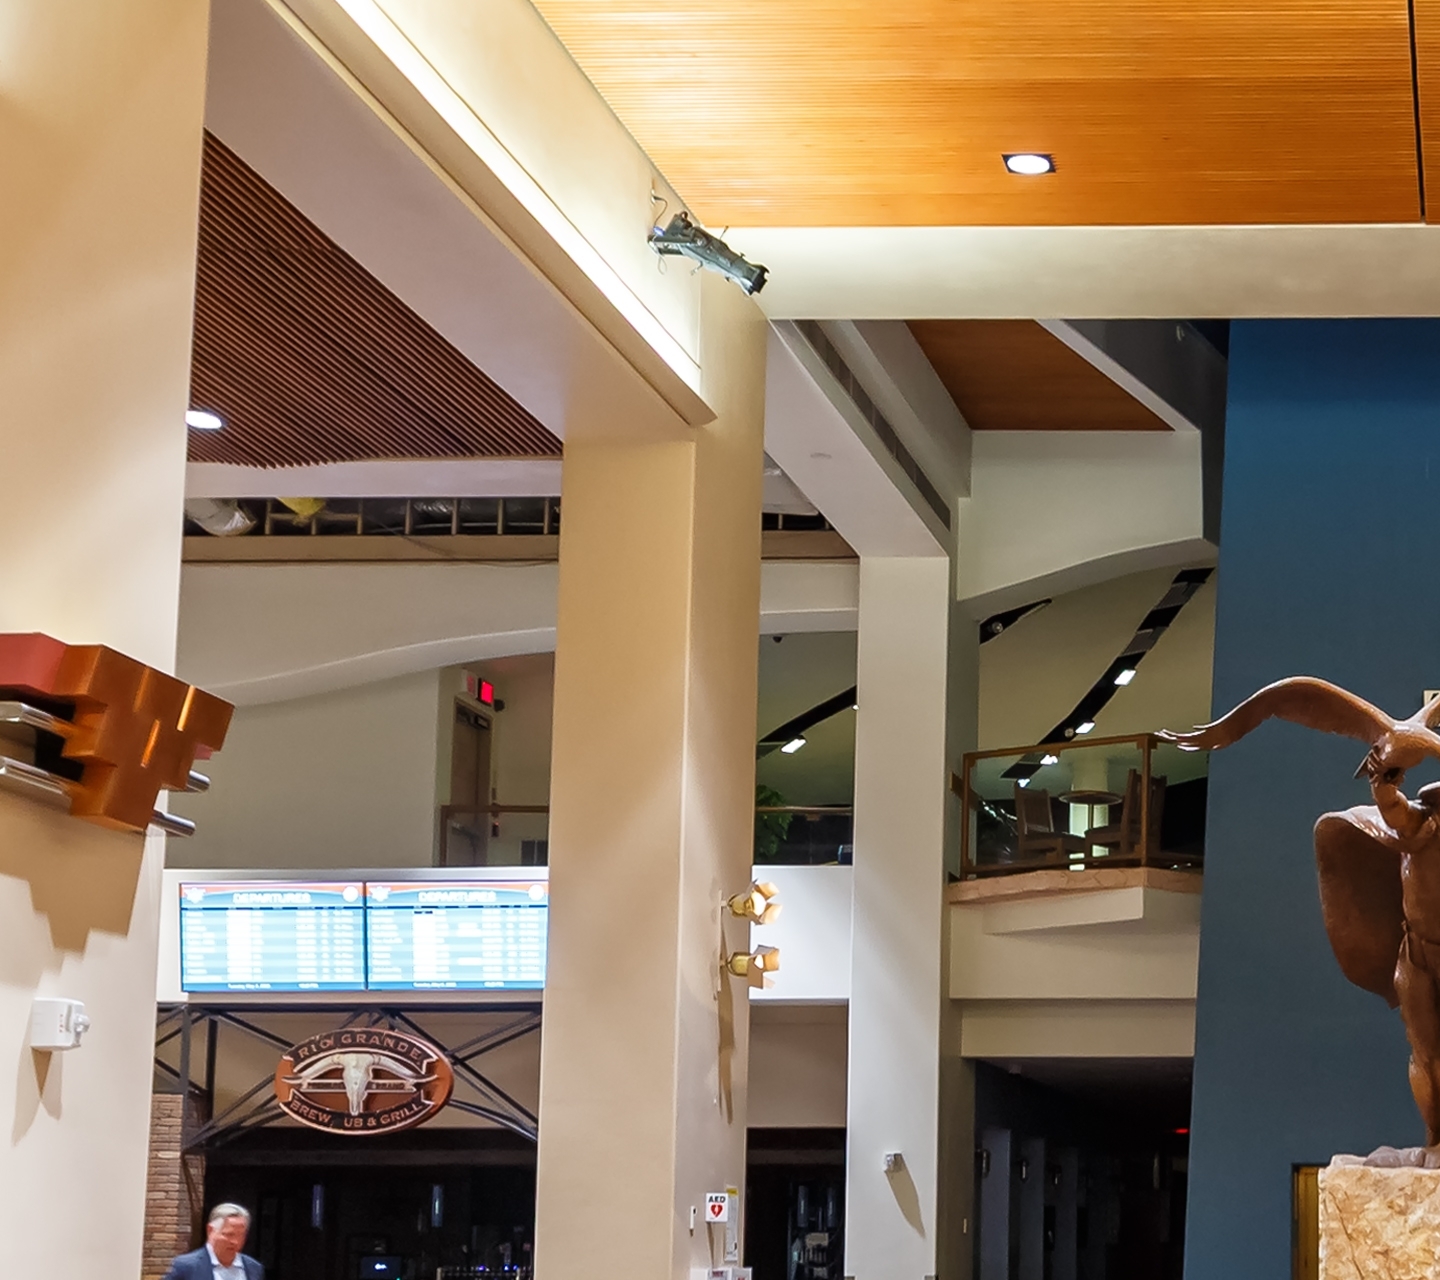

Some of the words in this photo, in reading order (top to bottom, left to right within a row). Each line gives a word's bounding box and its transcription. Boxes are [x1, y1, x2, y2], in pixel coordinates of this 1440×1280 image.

[233, 893, 311, 904] DEPARTURES
[418, 891, 497, 902] DEPARTURES
[298, 1038, 334, 1060] RIO
[341, 1033, 423, 1060] GRANDE
[380, 1102, 424, 1125] GRILL
[708, 1195, 726, 1204] AED
